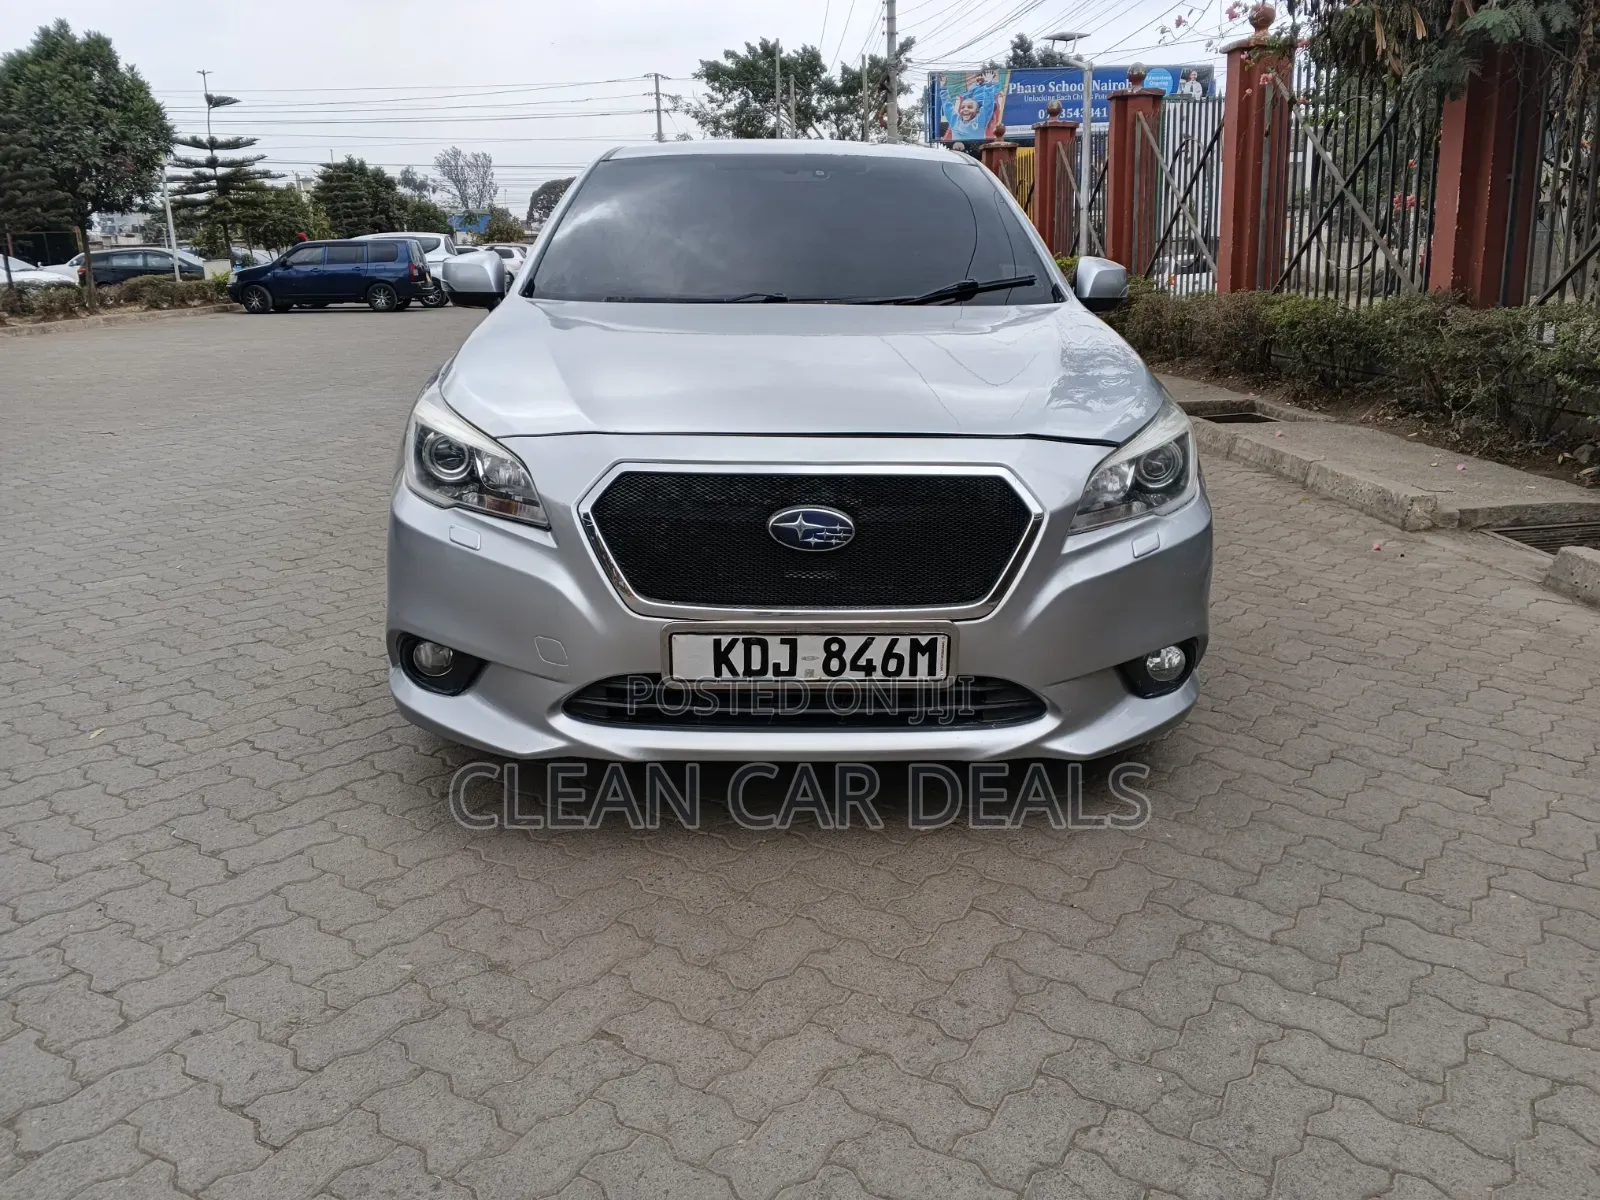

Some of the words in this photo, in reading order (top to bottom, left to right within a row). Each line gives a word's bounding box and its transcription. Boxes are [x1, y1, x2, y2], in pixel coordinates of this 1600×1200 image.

[1009, 82, 1045, 94] Pharo
[1049, 80, 1084, 93] Schoo
[1092, 79, 1132, 91] Nairob
[712, 637, 798, 678] KDJ
[821, 636, 939, 677] 846M
